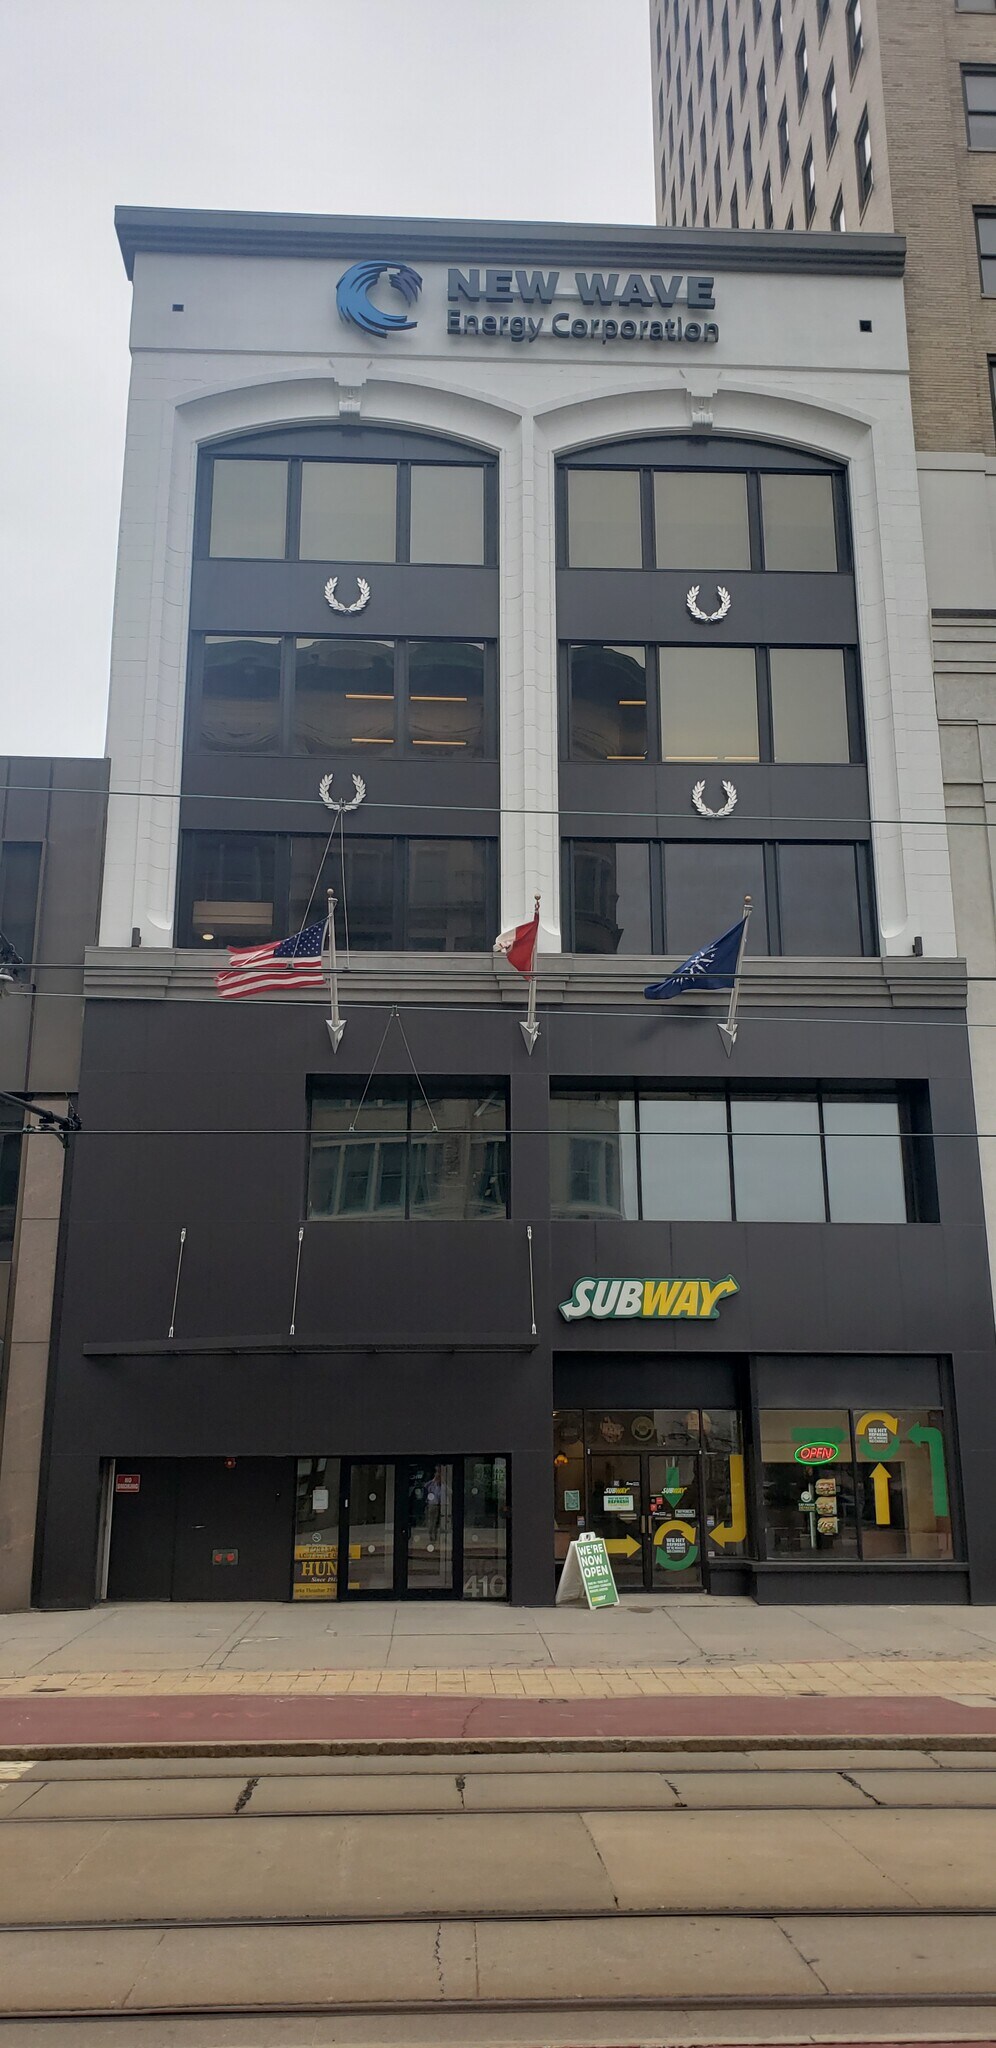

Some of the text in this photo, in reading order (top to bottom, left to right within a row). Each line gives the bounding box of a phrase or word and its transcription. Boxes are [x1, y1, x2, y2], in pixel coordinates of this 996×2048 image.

[447, 268, 715, 310] NEW WAVE
[446, 309, 720, 345] Energy Corporation
[560, 1277, 738, 1319] SUBWAY
[800, 1447, 834, 1459] OPEN
[577, 1543, 604, 1556] WE'RE
[581, 1554, 603, 1567] NOW
[584, 1565, 609, 1578] OPEN
[463, 1574, 507, 1598] 410
